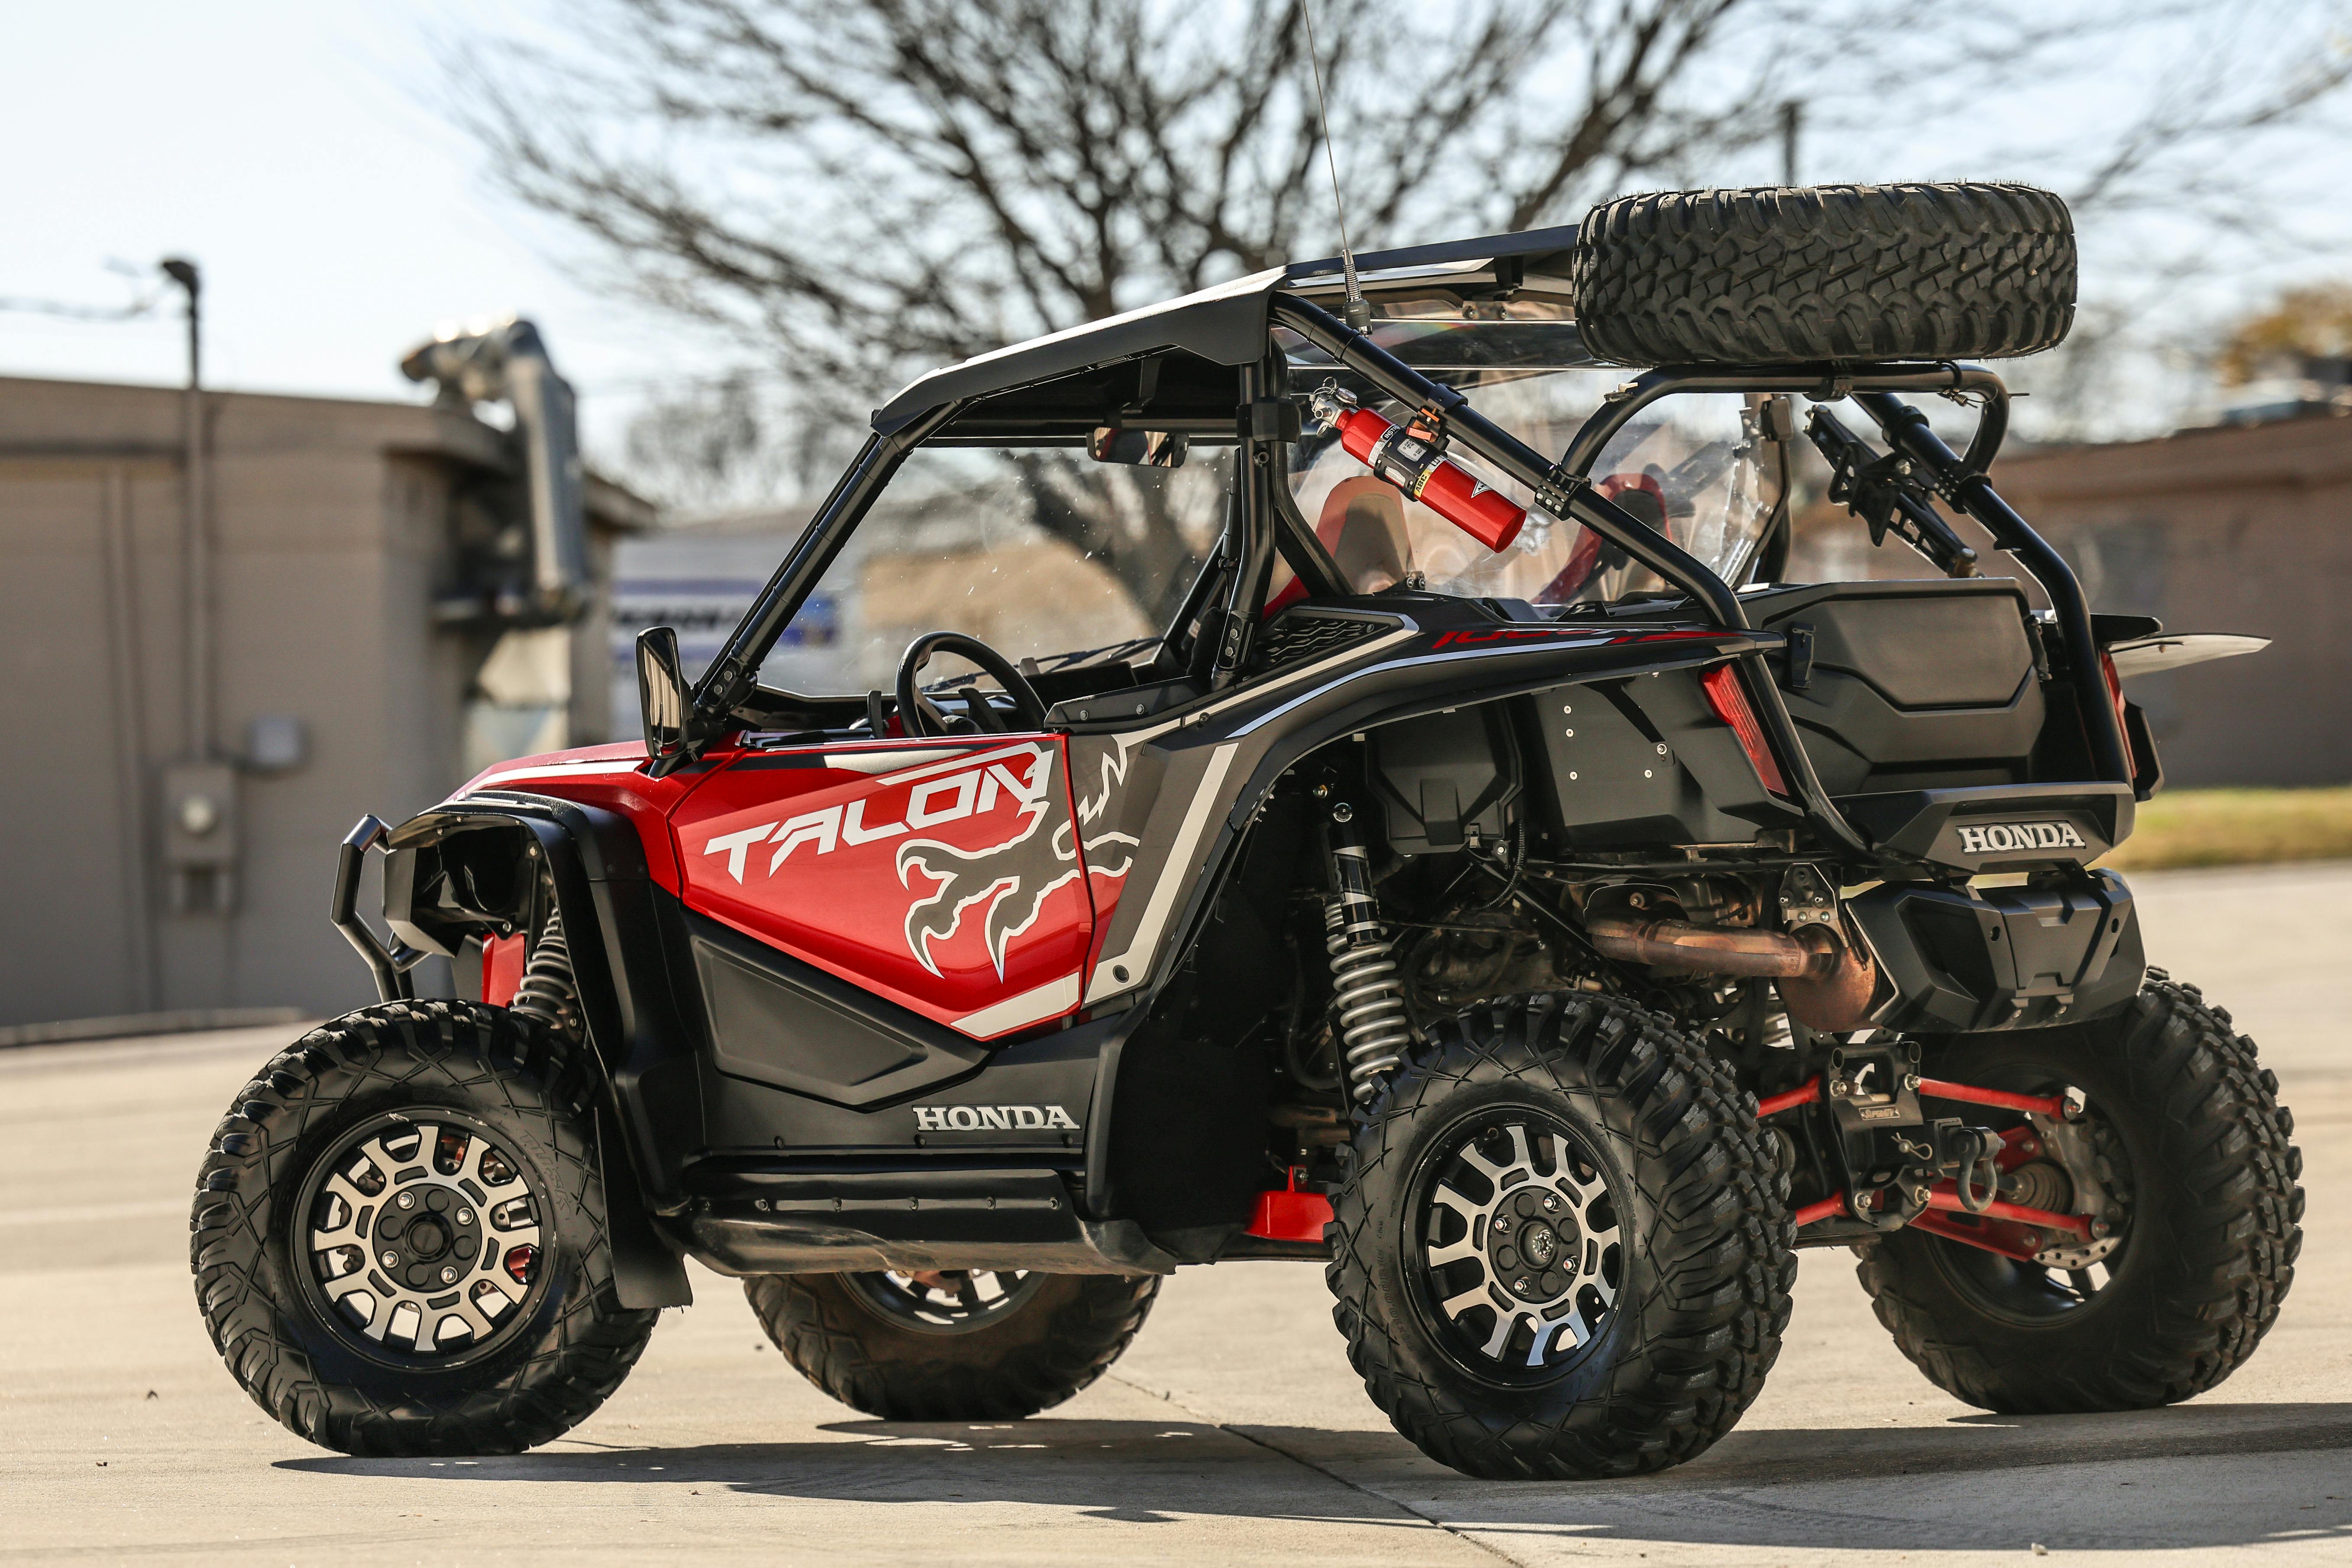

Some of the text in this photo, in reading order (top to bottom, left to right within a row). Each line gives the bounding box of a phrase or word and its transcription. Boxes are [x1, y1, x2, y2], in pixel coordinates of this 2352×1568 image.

[1416, 474, 1427, 493] ABC
[704, 742, 1054, 885] TALON
[1958, 823, 2085, 853] HONDA
[913, 1106, 1080, 1131] HONDA
[520, 1130, 572, 1214] TUSK
